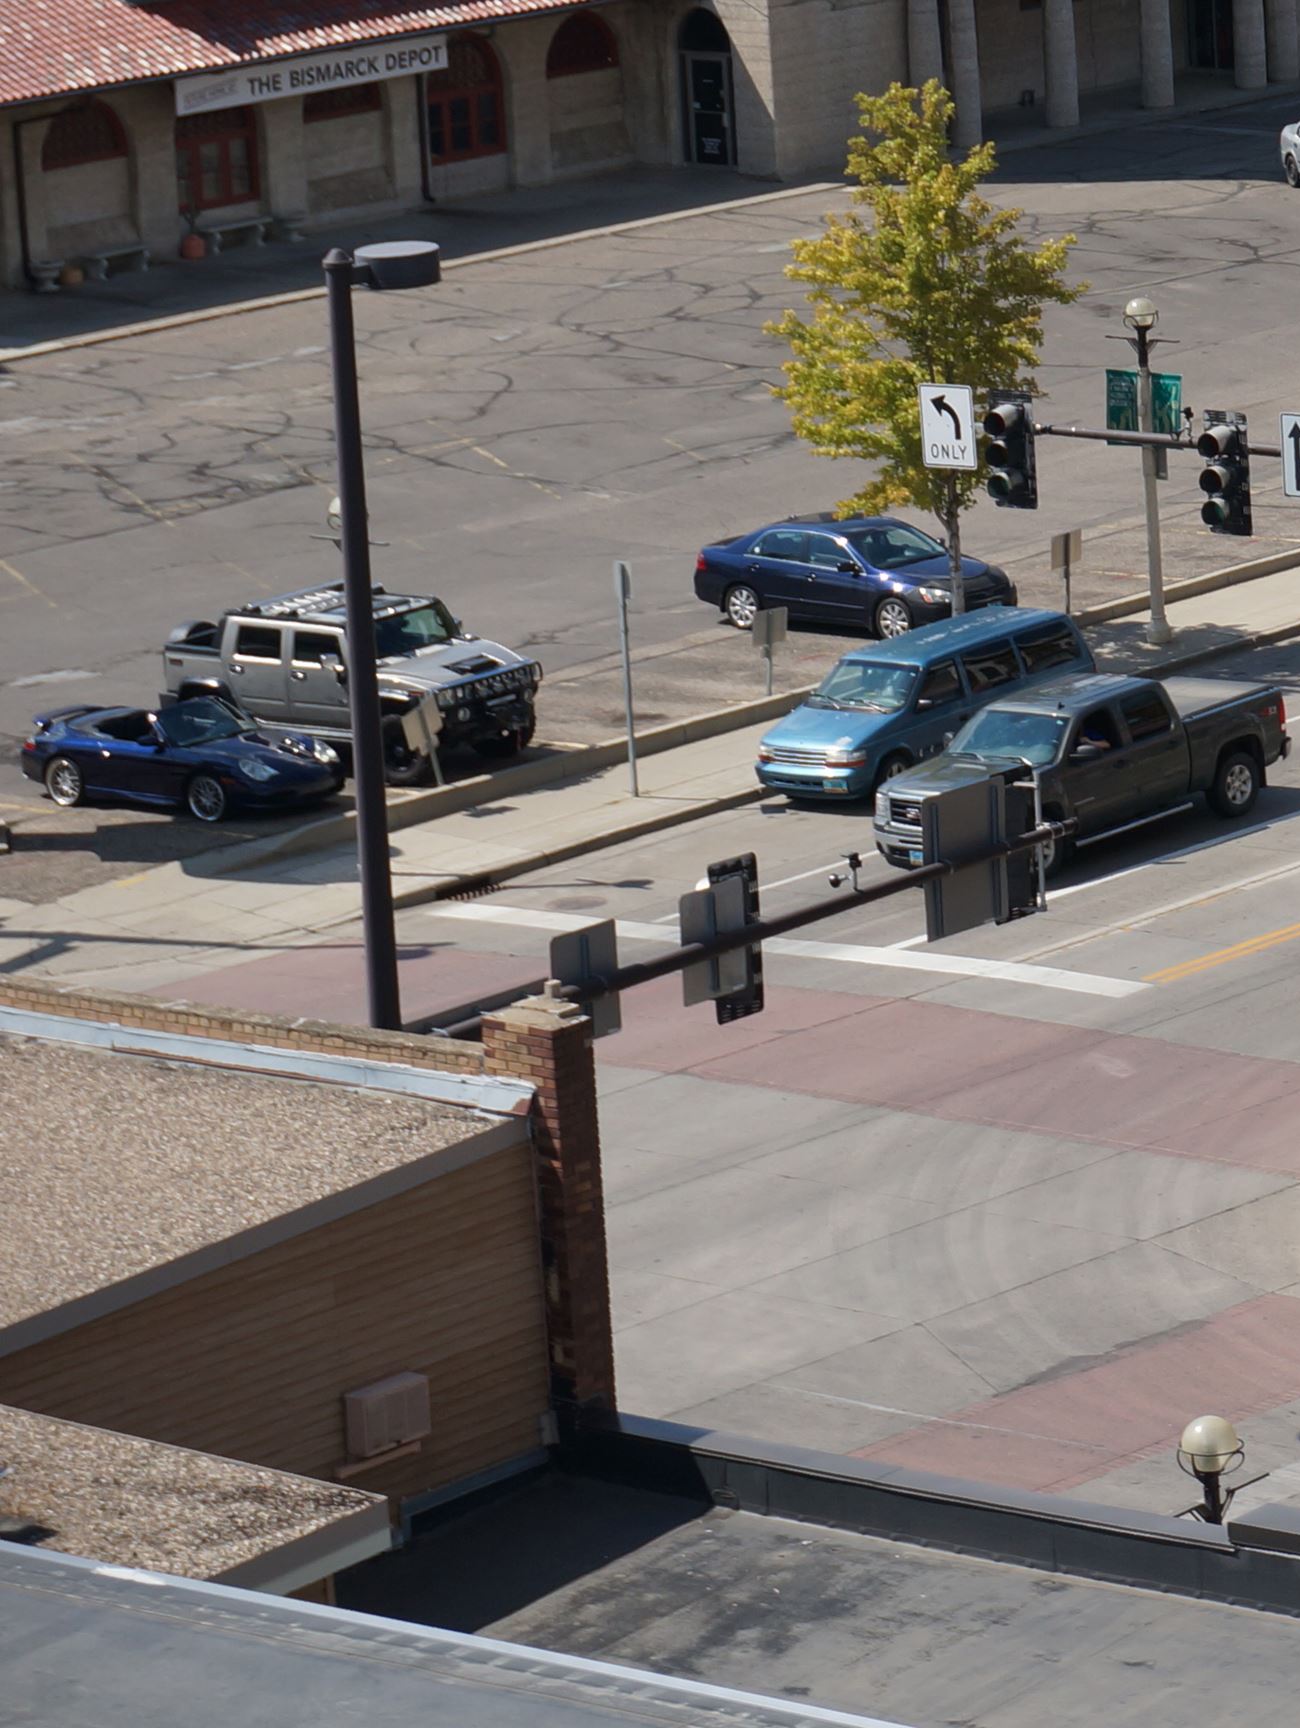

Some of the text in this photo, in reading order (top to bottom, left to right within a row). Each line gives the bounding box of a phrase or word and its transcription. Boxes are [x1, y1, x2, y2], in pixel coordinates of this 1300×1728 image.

[247, 73, 282, 96] THE
[289, 56, 380, 89] BISMARCK
[384, 45, 443, 71] DEPOT
[930, 443, 967, 460] ONLY
